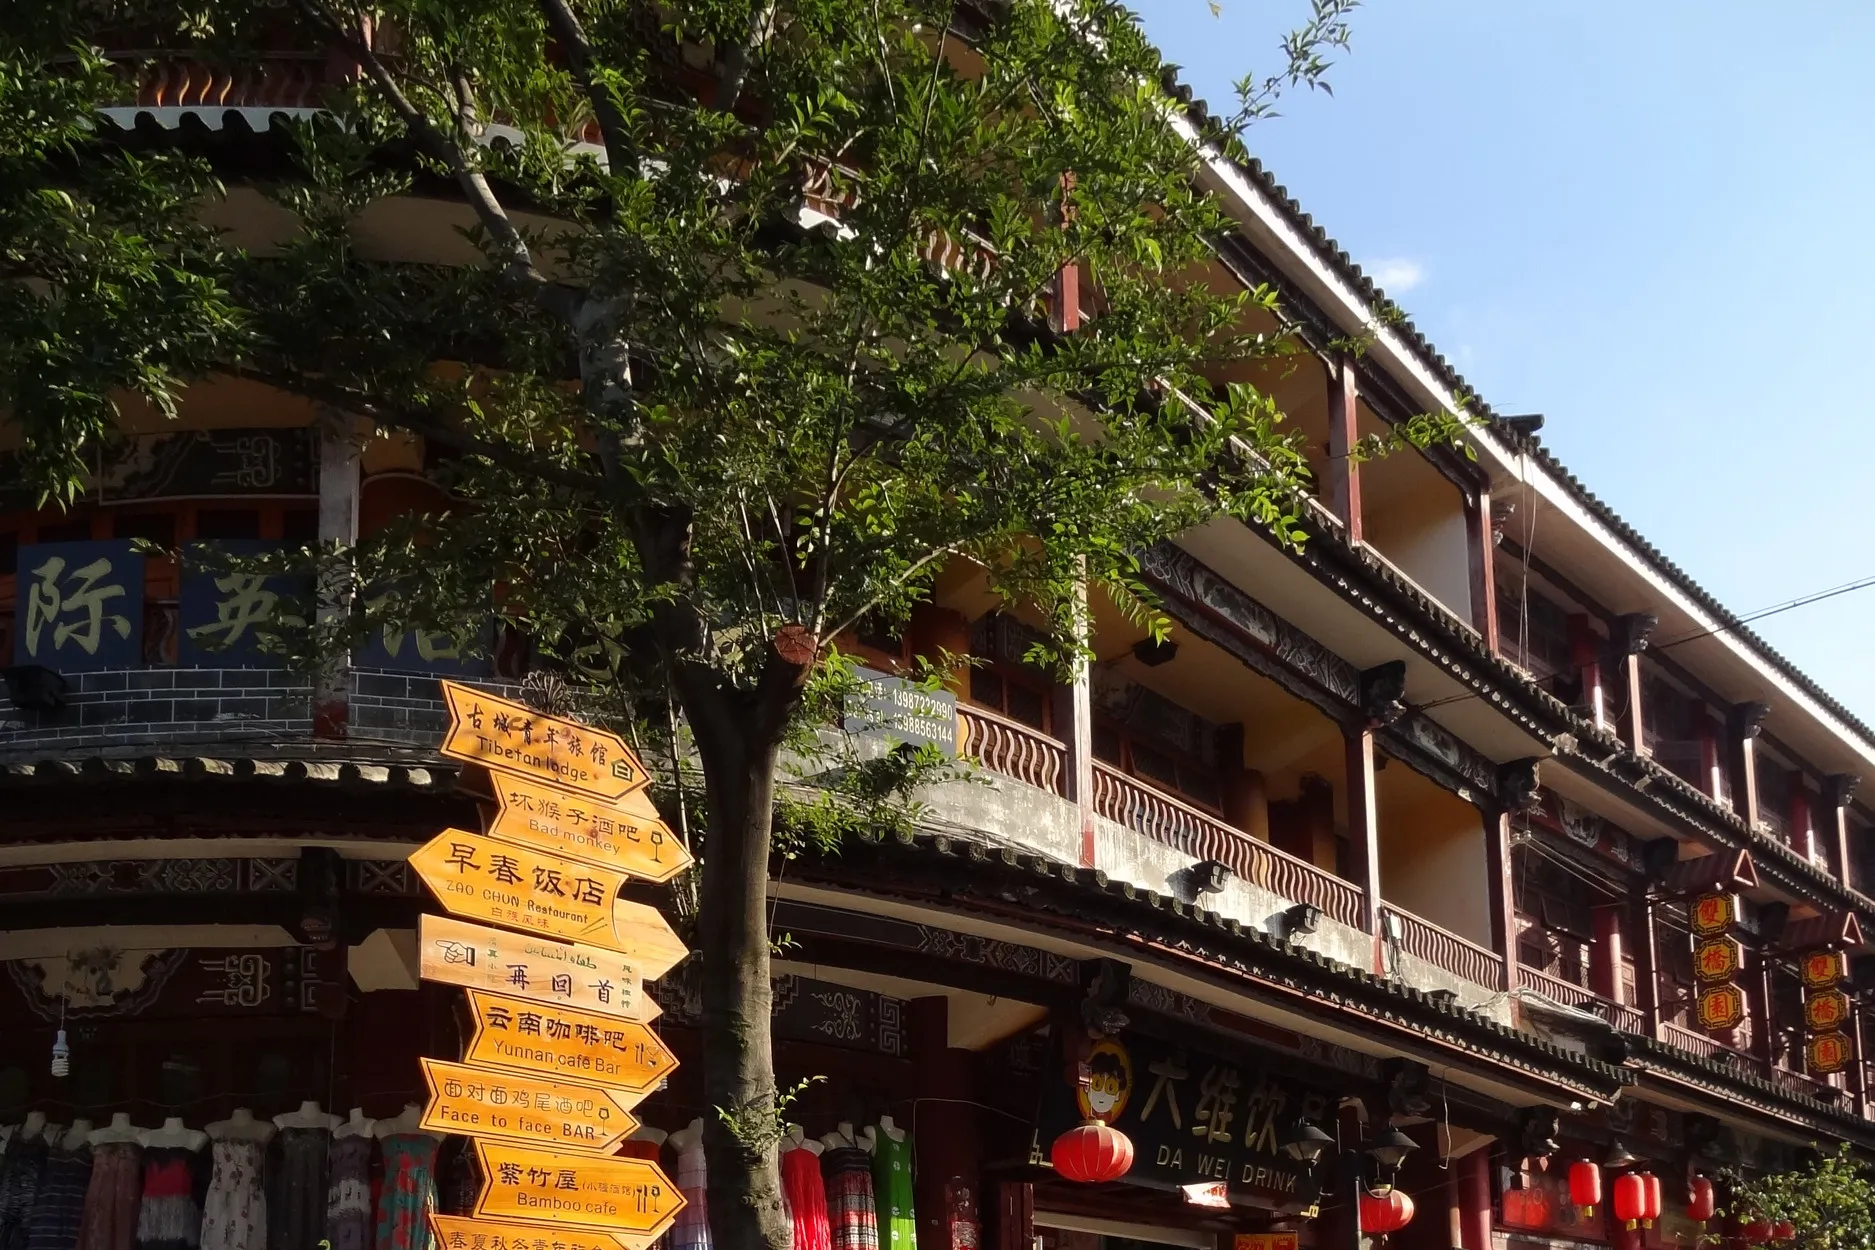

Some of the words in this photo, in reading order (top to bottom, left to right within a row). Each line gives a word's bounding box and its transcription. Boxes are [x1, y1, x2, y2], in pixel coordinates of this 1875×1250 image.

[467, 702, 607, 766] 古城青年旅馆
[476, 735, 541, 768] Tibetan
[546, 755, 588, 781] lodge
[509, 792, 640, 843] 坏猴子酒吧
[529, 819, 558, 837] Bad
[563, 830, 620, 856] monkey
[445, 842, 605, 906] 早春饭店
[446, 880, 474, 896] ZAO
[482, 889, 520, 908] CHUN
[527, 899, 588, 924] Restaurant
[491, 907, 549, 929] 白族风味
[505, 964, 614, 1005] 再回首
[486, 1006, 627, 1052] 云南咖啡吧
[493, 1039, 553, 1063] Yunnan
[595, 1057, 621, 1075] Bar
[444, 1077, 593, 1118] 面对面鸡尾酒吧
[441, 1105, 479, 1124] Face
[492, 1114, 507, 1127] to
[519, 1117, 552, 1134] face
[562, 1123, 595, 1140] BAR
[498, 1162, 579, 1191] 紫竹屋
[1156, 1145, 1183, 1170] DA
[1197, 1152, 1231, 1180] WEI
[1241, 1164, 1298, 1194] DRINK
[517, 1192, 581, 1212] Bamboo
[585, 1201, 617, 1215] cafe
